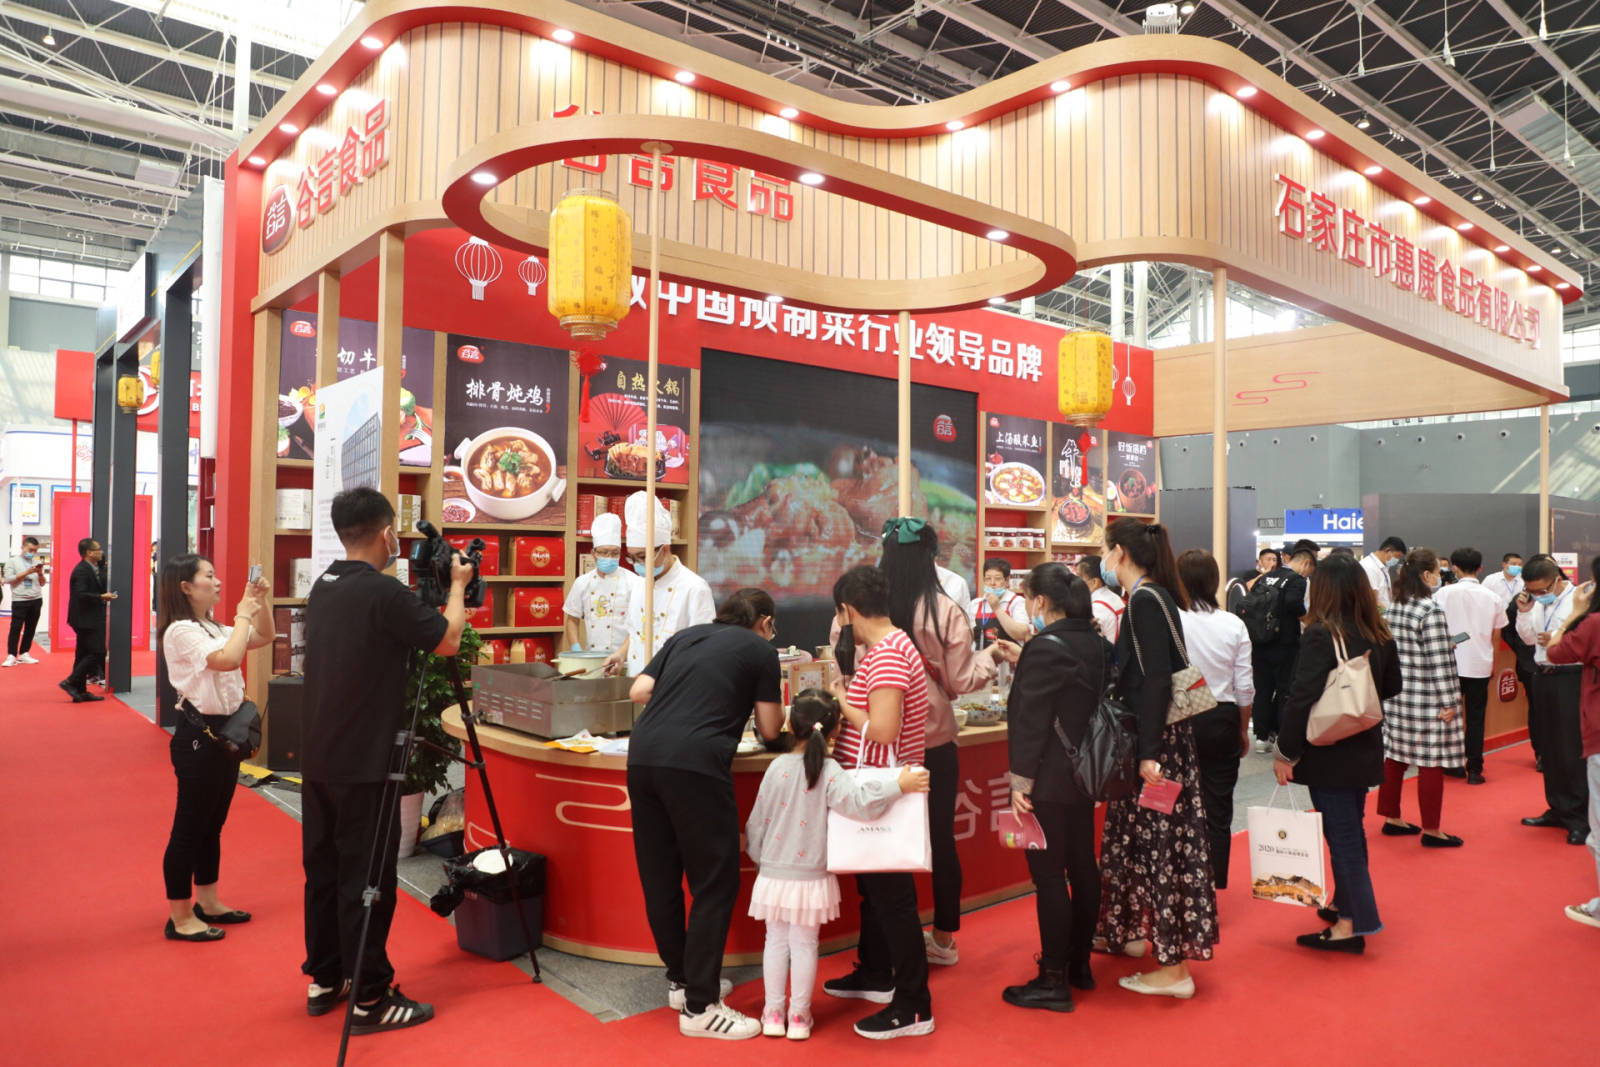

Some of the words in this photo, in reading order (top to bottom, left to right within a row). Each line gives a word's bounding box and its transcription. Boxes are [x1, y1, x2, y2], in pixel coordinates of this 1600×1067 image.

[297, 98, 391, 231] 谷言食品
[1274, 172, 1541, 349] 石家庄市惠康食品有限公司
[465, 378, 544, 406] 排骨炖鸡
